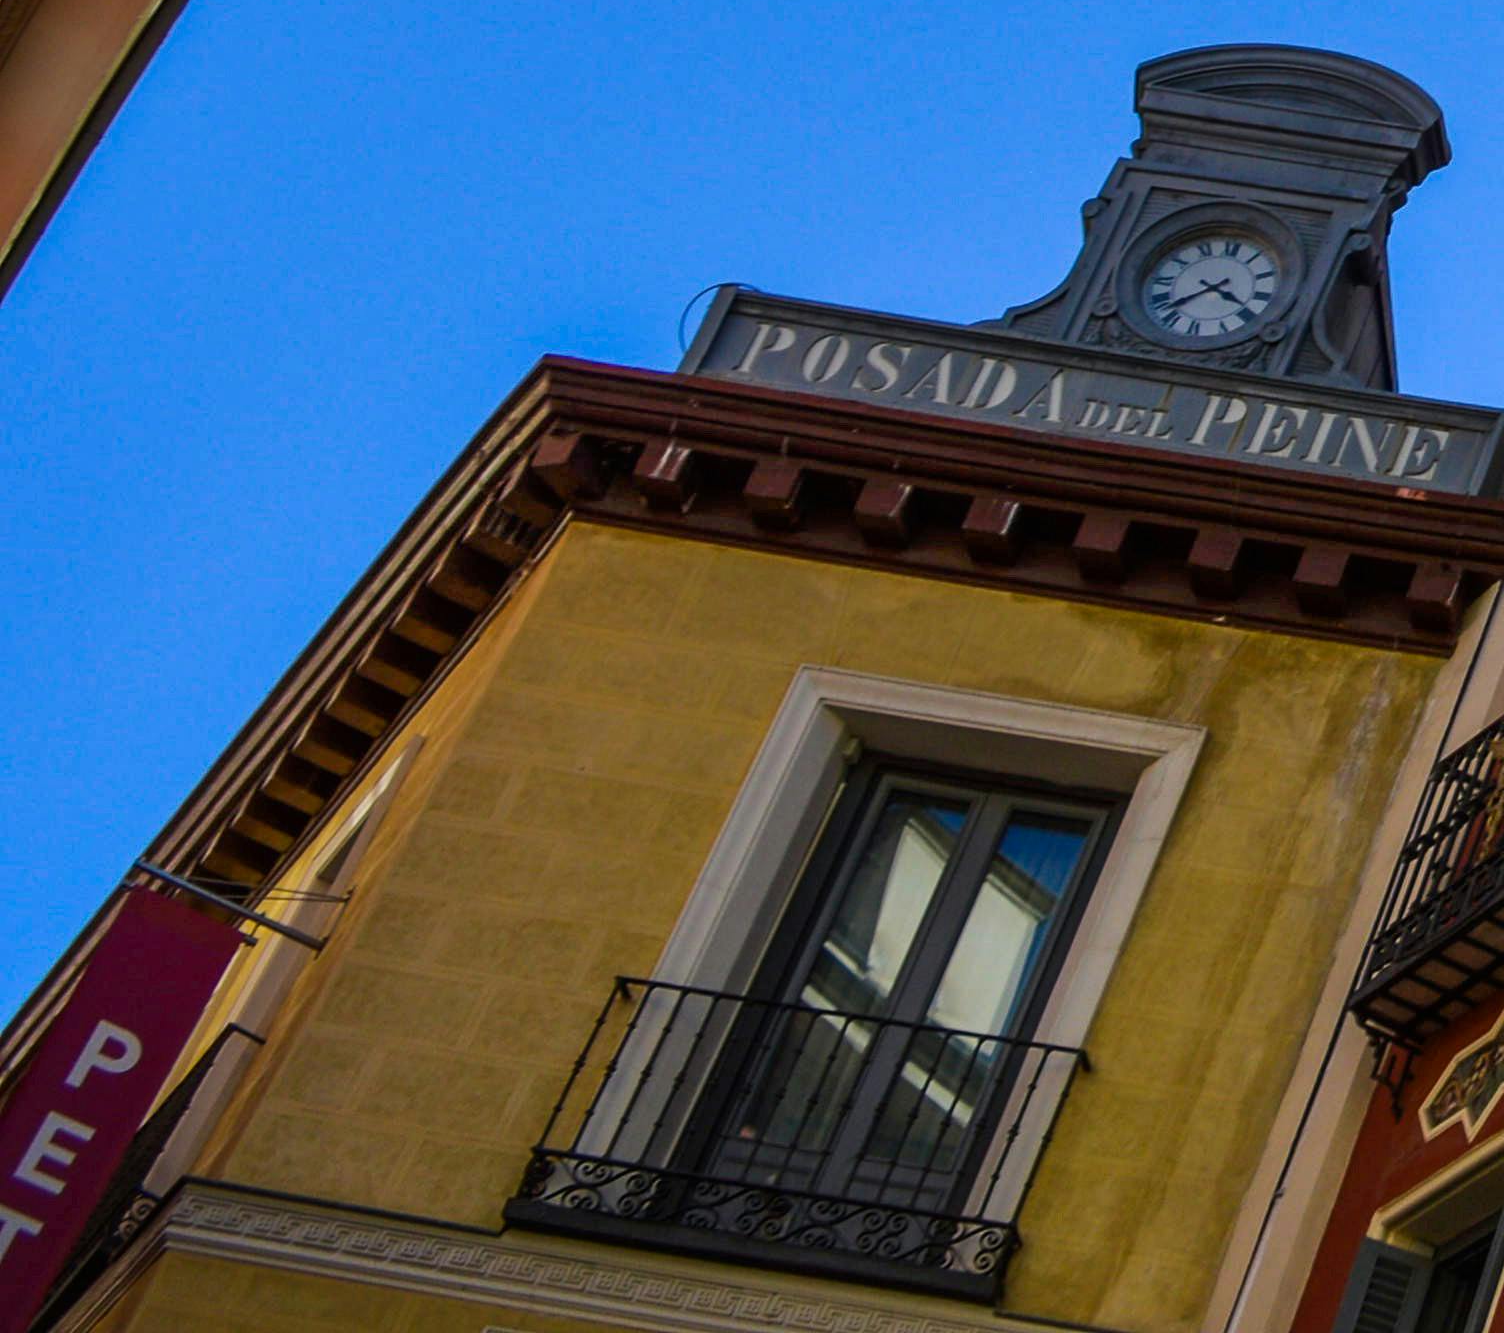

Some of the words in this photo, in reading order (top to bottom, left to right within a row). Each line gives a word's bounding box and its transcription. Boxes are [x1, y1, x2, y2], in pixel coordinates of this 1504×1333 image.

[735, 322, 1064, 422] POSADA
[1076, 399, 1173, 439] DEL
[1187, 393, 1449, 480] PEINE
